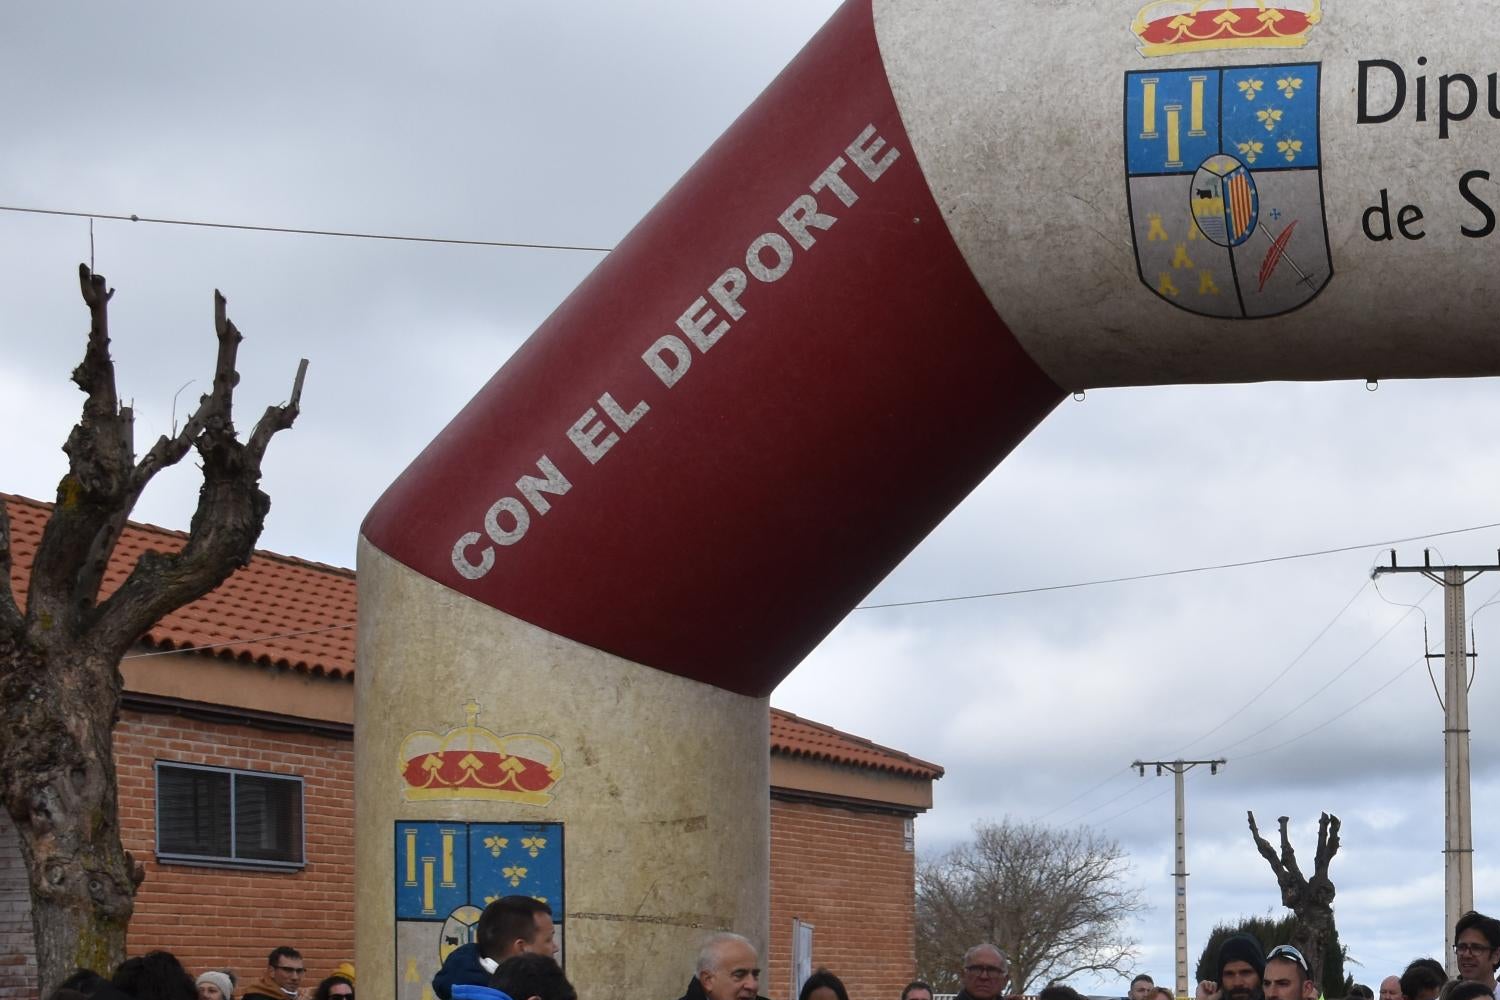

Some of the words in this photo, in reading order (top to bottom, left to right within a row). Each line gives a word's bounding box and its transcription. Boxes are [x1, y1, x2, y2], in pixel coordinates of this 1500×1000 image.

[1361, 188, 1427, 242] de
[450, 455, 573, 581] CON
[566, 391, 651, 465] EL
[641, 123, 901, 389] DEPORTE
